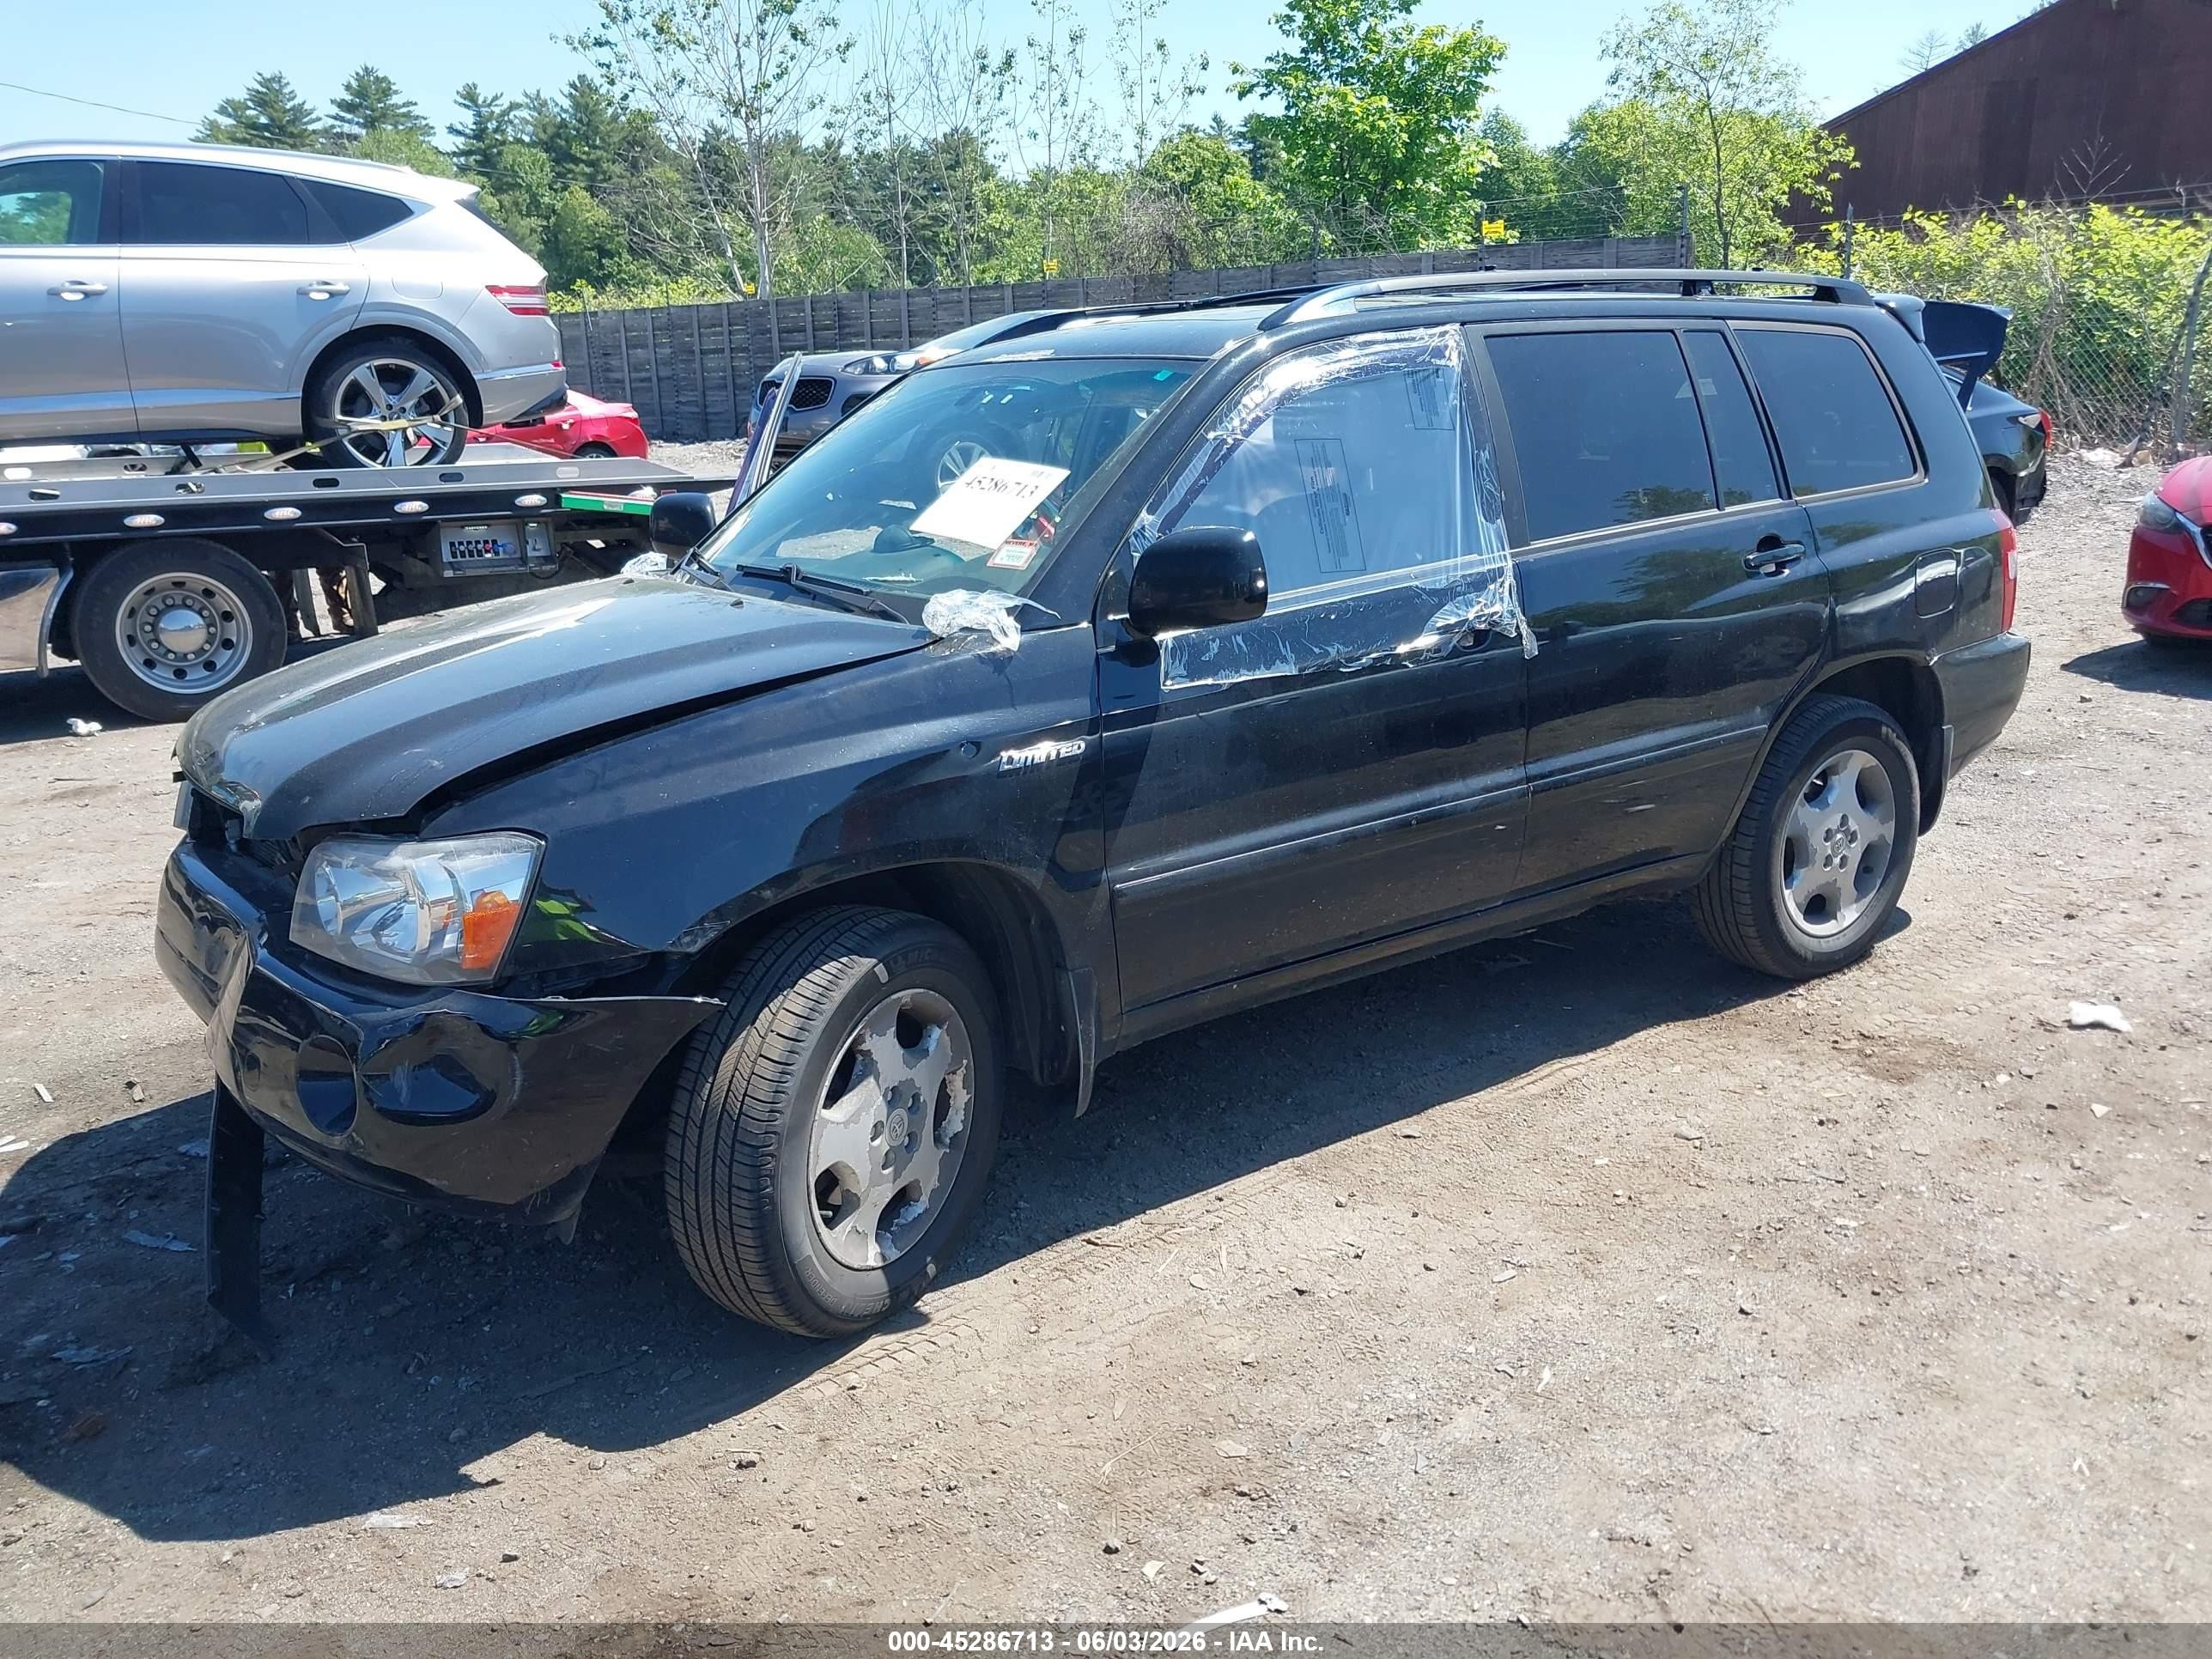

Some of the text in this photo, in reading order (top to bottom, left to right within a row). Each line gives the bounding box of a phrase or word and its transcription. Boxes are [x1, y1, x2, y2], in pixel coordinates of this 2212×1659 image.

[965, 476, 1039, 498] 45286713
[999, 741, 1085, 771] LIMITED
[805, 1267, 838, 1305] DEFENDER
